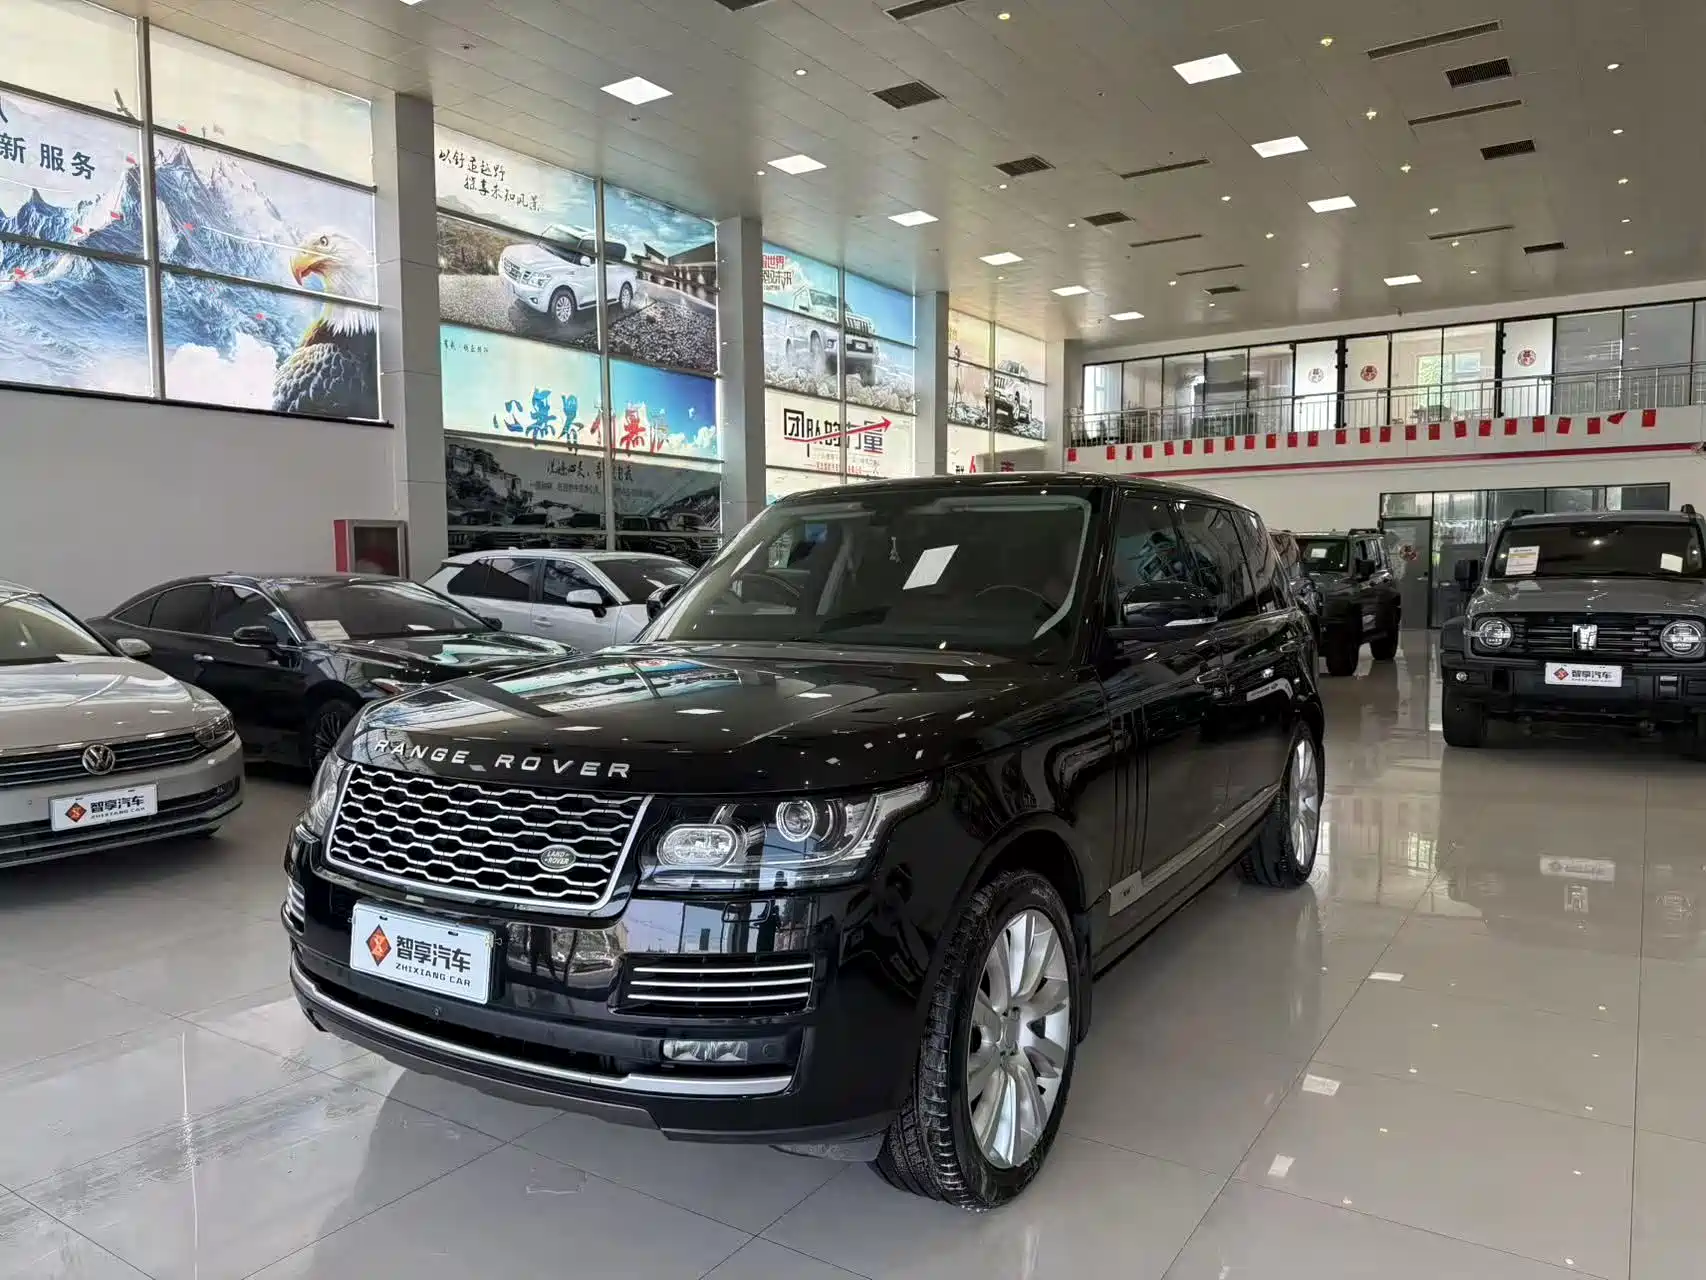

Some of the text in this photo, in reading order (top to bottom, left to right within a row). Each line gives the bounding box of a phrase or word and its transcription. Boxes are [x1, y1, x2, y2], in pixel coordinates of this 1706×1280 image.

[40, 143, 96, 180] 服务
[373, 739, 632, 779] RANGE ROVER
[90, 795, 145, 814] 智享汽车
[396, 935, 472, 973] 智享汽车
[395, 962, 472, 988] ZHIXIANG CAR
